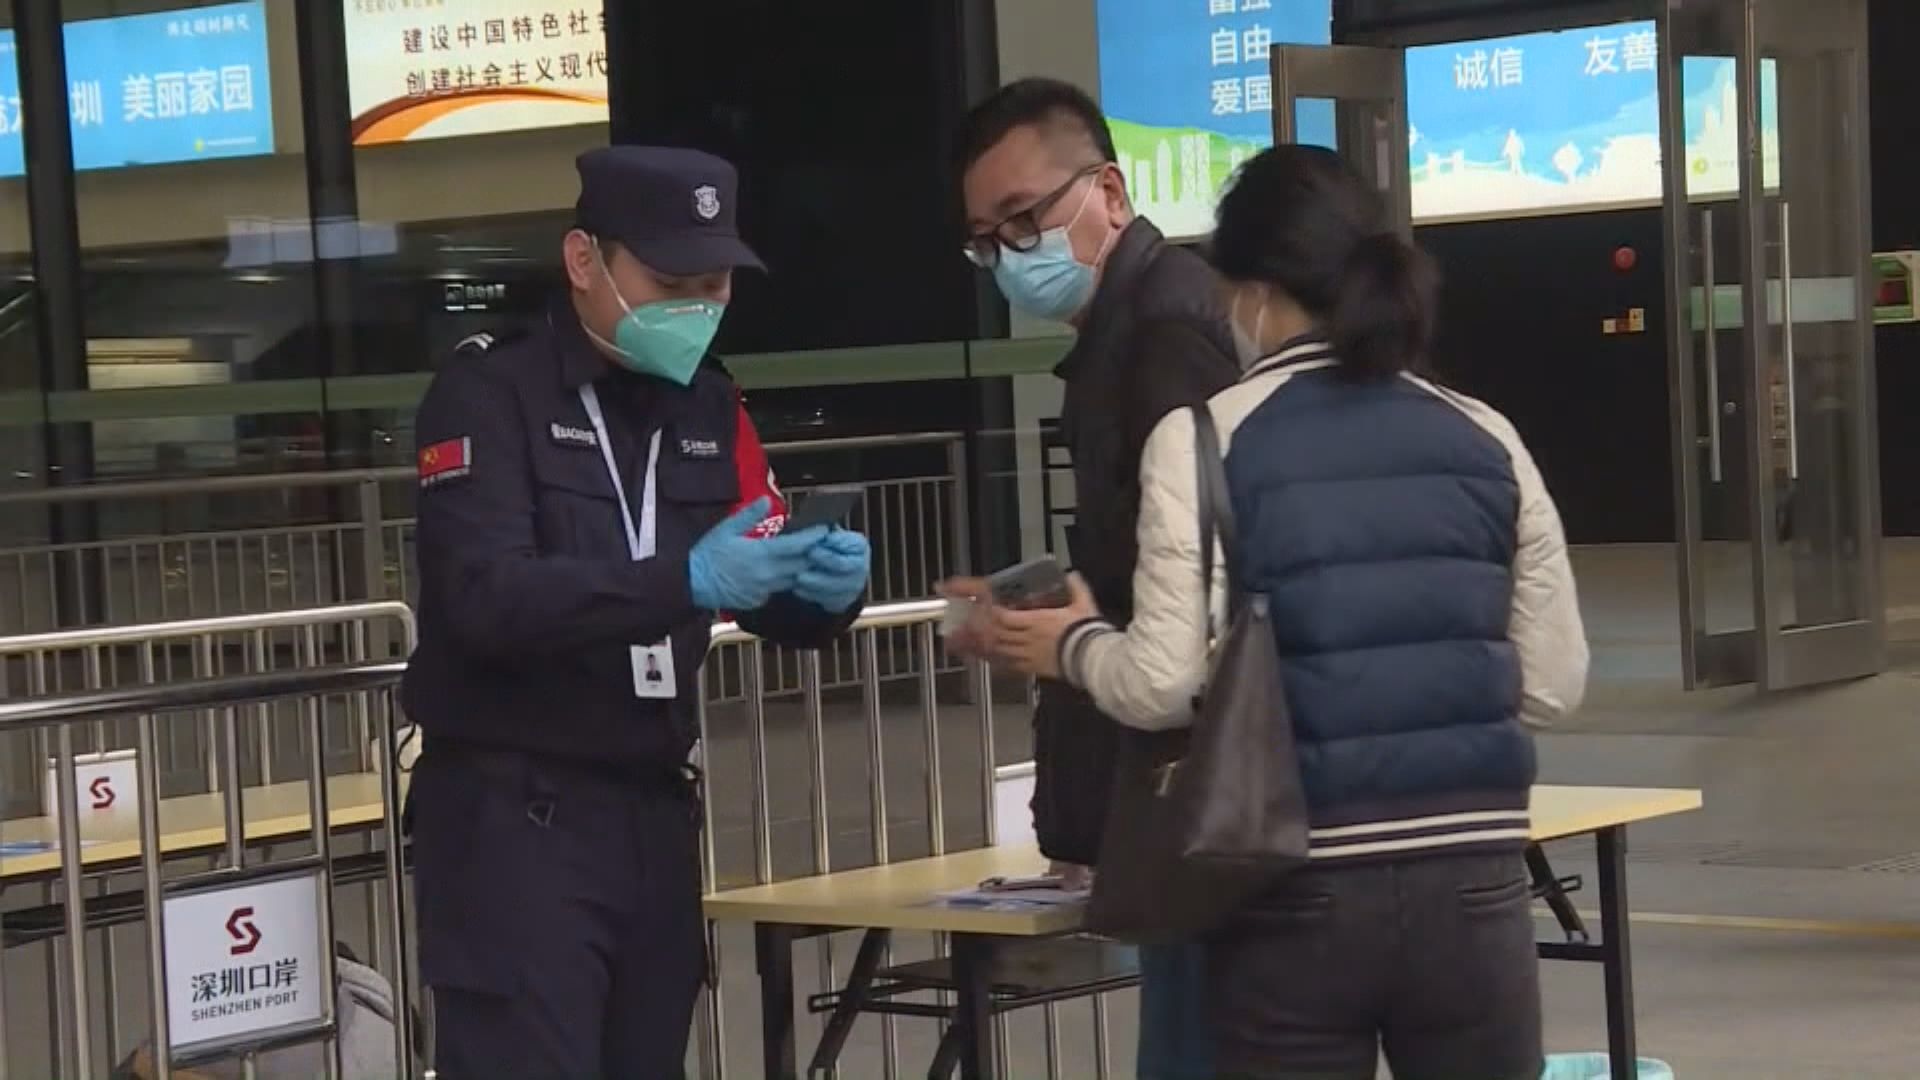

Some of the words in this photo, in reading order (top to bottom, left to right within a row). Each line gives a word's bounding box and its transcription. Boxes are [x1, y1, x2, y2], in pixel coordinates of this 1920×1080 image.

[402, 9, 607, 54] 建设中国特色社
[1210, 23, 1271, 66] 自由
[405, 51, 608, 97] 创建社会主义现代
[1453, 46, 1524, 90] 诚信
[1583, 30, 1657, 76] 友善
[122, 64, 253, 123] 美丽家园
[1211, 74, 1272, 115] 爱国
[191, 957, 298, 1004] 深圳口岸
[191, 997, 262, 1021] SHENZHEN
[264, 990, 299, 1007] PORT
